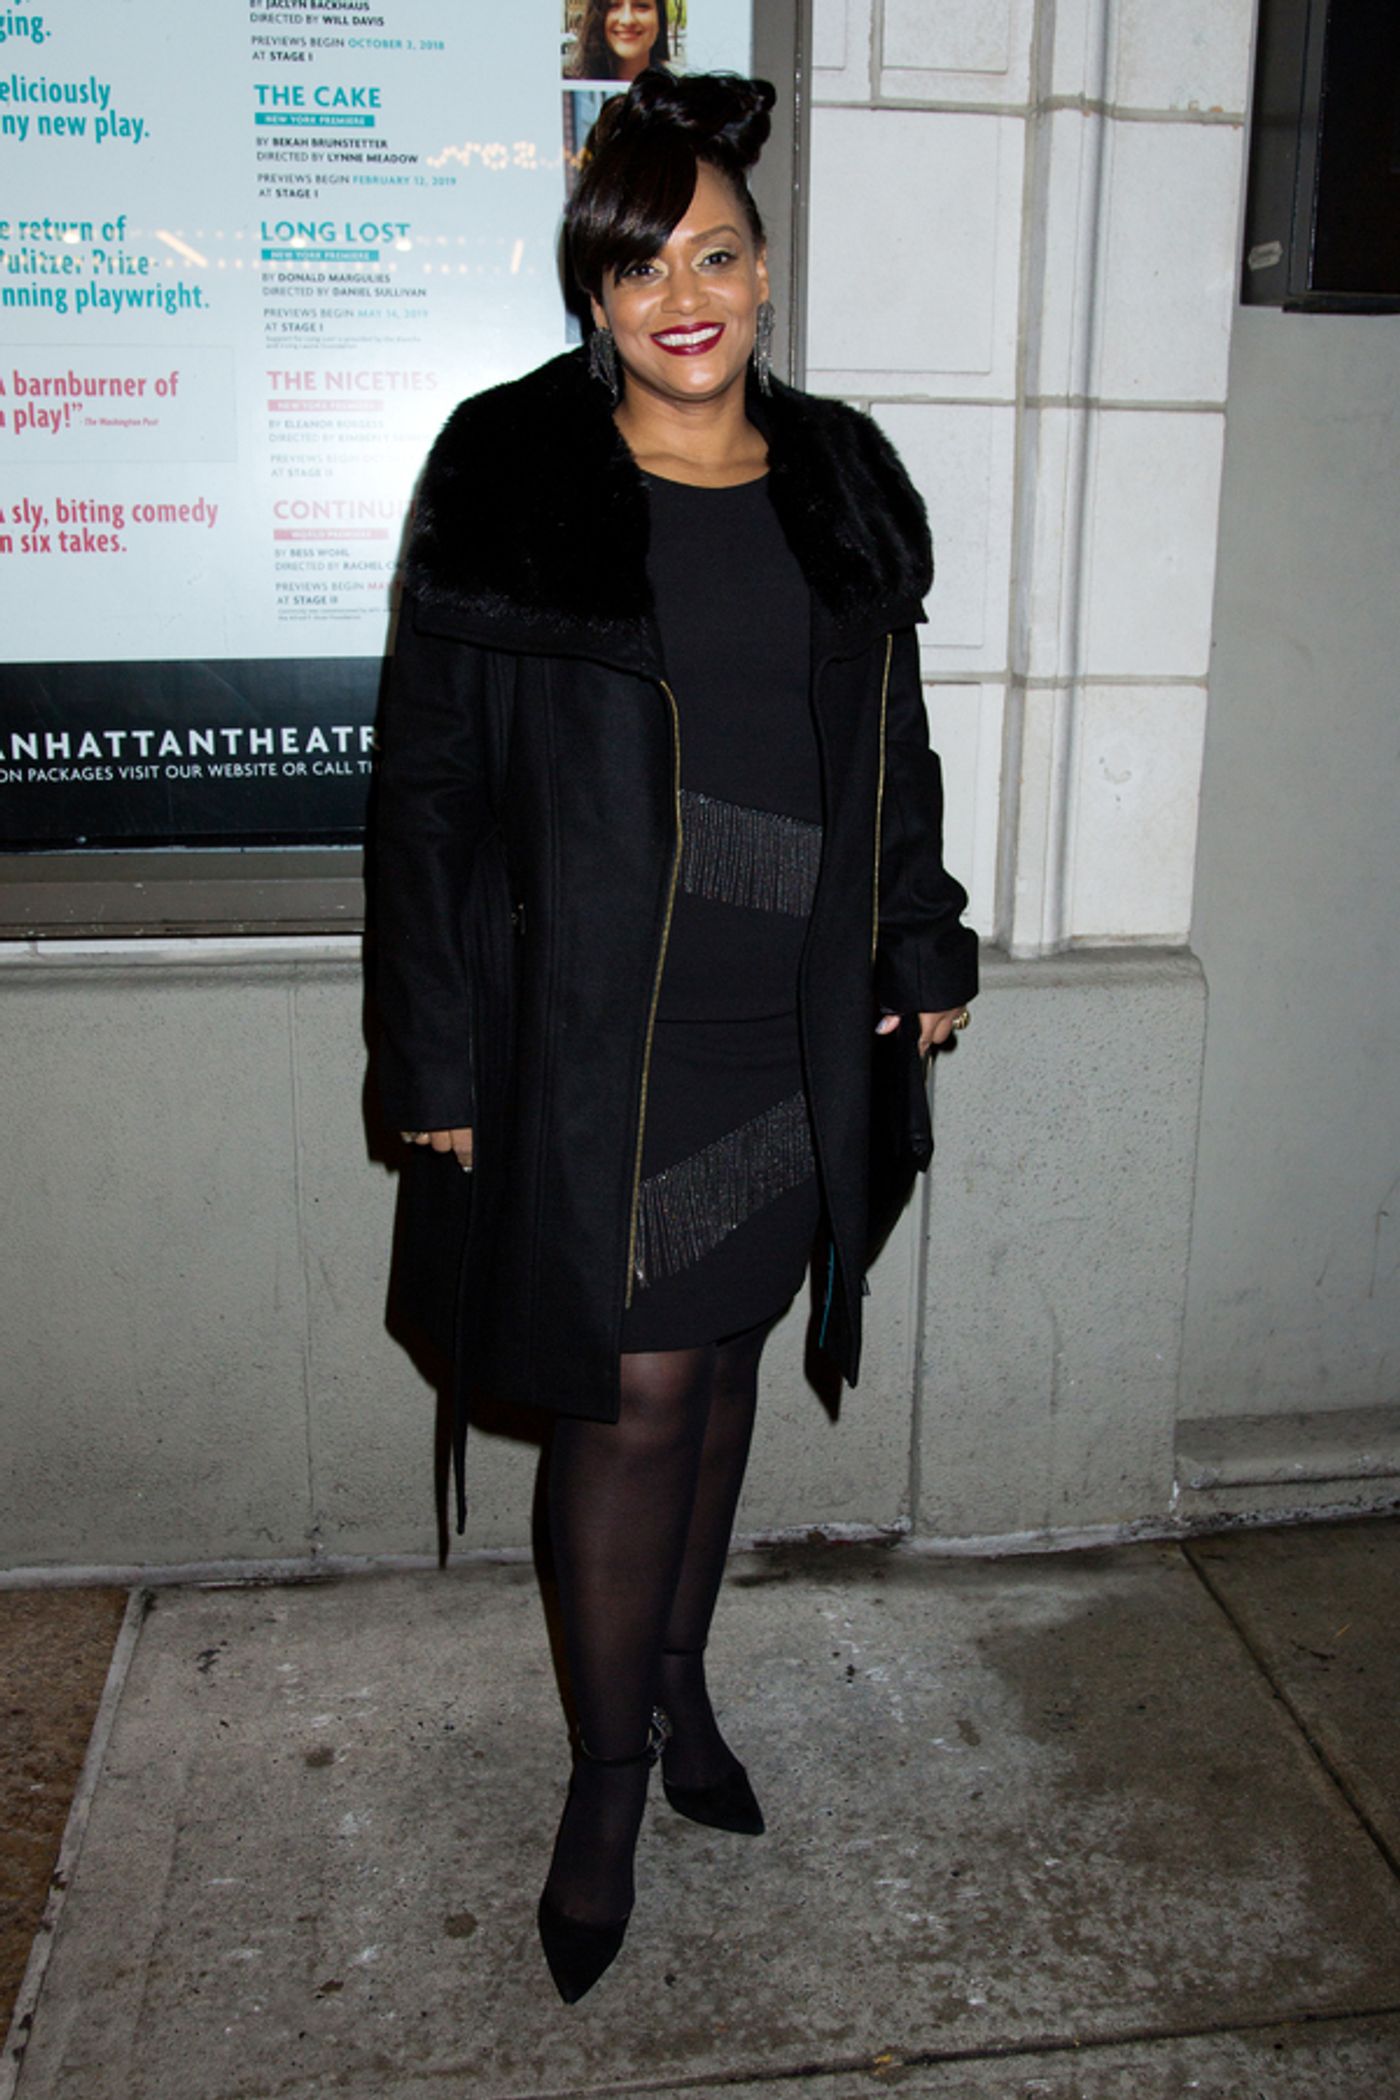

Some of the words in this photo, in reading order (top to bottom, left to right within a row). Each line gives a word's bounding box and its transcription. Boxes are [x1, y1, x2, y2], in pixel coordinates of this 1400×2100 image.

[250, 14, 301, 24] DIRECTED
[306, 15, 319, 24] BY
[322, 16, 349, 25] WILL
[352, 16, 384, 26] DAVIS
[251, 36, 307, 47] PREVIEWS
[310, 37, 344, 47] BEGIN
[348, 39, 402, 49] OCTOBER
[419, 41, 445, 50] 2018
[252, 51, 266, 60] AT
[270, 52, 304, 61] STAGE
[0, 74, 111, 111] eliciously
[254, 84, 306, 106] THE
[313, 86, 382, 108] CAKE
[38, 115, 87, 136] new
[95, 110, 150, 144] play.
[257, 137, 269, 147] BY
[273, 138, 309, 148] BEKAH
[257, 151, 308, 162] DIRECTED
[312, 152, 325, 162] BY
[327, 153, 363, 163] LYNNE
[366, 154, 418, 164] MEADOW
[257, 173, 312, 184] PREVIEWS
[315, 175, 349, 184] BEGIN
[353, 176, 410, 186] FEBRUARY
[259, 189, 273, 198] AT
[276, 190, 310, 199] STAGE
[19, 217, 93, 241] return
[101, 215, 127, 242] of
[261, 221, 336, 242] LONG
[346, 222, 411, 243] LOST
[262, 273, 275, 282] BY
[277, 273, 325, 283] DONALD
[328, 273, 391, 284] MARGULIES
[2, 283, 67, 315] nning
[76, 280, 210, 315] playwright.
[262, 287, 313, 297] DIRECTED
[317, 287, 329, 297] BY
[332, 288, 371, 297] DANIEL
[375, 287, 427, 298] SULLIVAN
[263, 308, 317, 318] PREVIEWS
[320, 308, 354, 319] BEGIN
[264, 322, 277, 332] AT
[281, 322, 316, 333] STAGE
[13, 369, 147, 397] barnburner
[155, 370, 180, 397] of
[266, 371, 317, 391] THE
[325, 372, 438, 392] NICETIES
[12, 497, 48, 533] sly,
[55, 497, 125, 529] biting
[132, 497, 218, 528] comedy
[21, 530, 51, 553] six
[58, 527, 127, 553] takes.
[275, 560, 324, 571] DIRECTED
[276, 582, 328, 592] PREVIEWS
[331, 582, 365, 592] BEGIN
[293, 596, 327, 607] STAGE
[0, 725, 376, 760] NHATTANTHEATR
[28, 766, 113, 783] PACKAGES
[119, 764, 160, 780] VISIT
[166, 764, 203, 780] OUR
[207, 762, 278, 778] WEBSITE
[284, 761, 307, 776] OR
[313, 760, 354, 777] CALL
